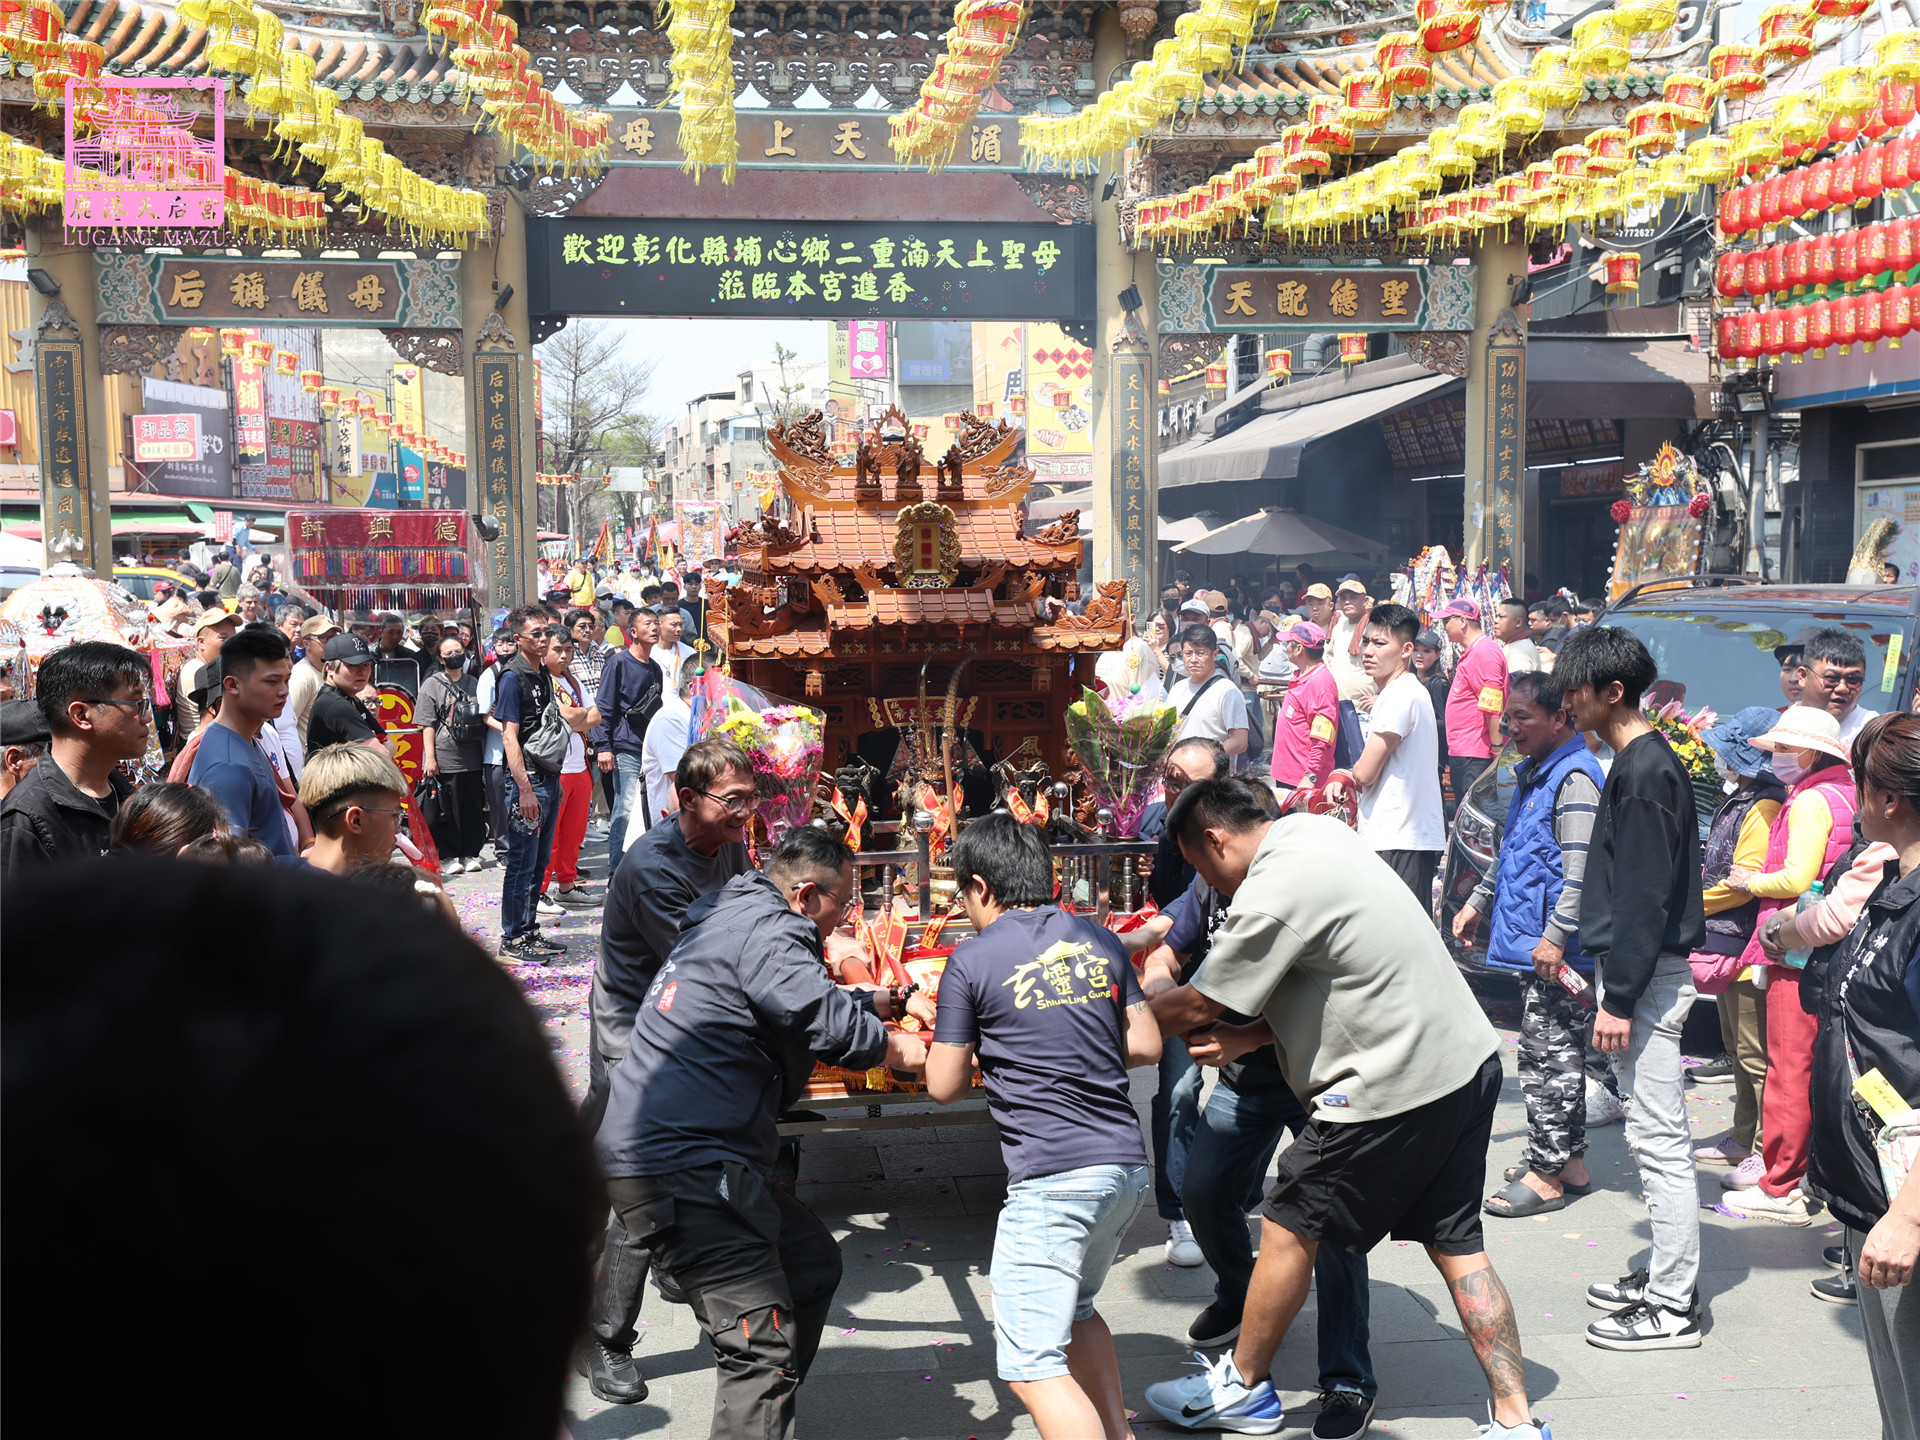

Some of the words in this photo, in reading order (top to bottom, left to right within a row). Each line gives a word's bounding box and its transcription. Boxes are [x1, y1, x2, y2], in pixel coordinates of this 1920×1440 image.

[619, 118, 1002, 163] 湄天上母
[561, 232, 1062, 270] 歡迎彰化縣埔心鄉二重湳天上聖母
[718, 271, 915, 303] 蒞臨本宮進香
[857, 321, 879, 353] 趣
[909, 365, 944, 377] 護理科
[142, 420, 188, 438] 御品齋
[238, 415, 263, 427] 總店
[238, 430, 263, 443] 百年老店
[1497, 361, 1517, 574] 功德頻施士民廣被神
[489, 370, 511, 608] 后中后母儀稱后豆奠邦
[1088, 989, 1111, 999] Gung
